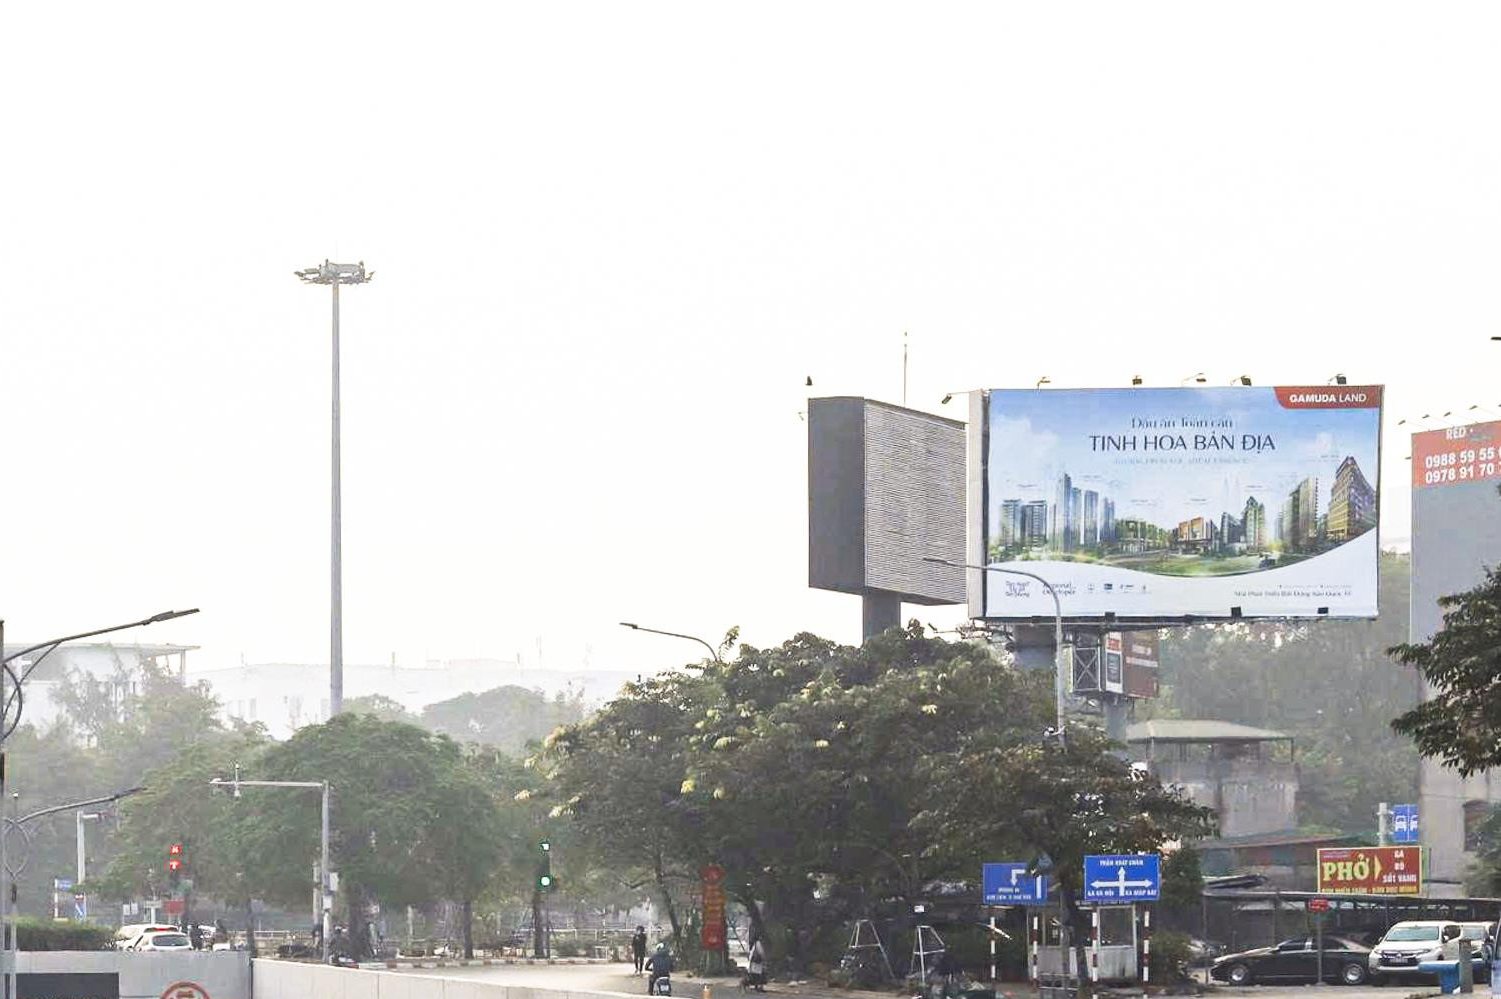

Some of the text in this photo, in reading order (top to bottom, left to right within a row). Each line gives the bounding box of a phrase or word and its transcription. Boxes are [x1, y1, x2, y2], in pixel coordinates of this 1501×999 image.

[1289, 392, 1366, 403] GAMUDA LAND
[1089, 431, 1276, 454] TINH HOA BẢN ĐỊA
[1425, 447, 1495, 469] 0988 59 55
[1425, 462, 1495, 484] 0978 91 70
[1321, 853, 1371, 881] PHỞ
